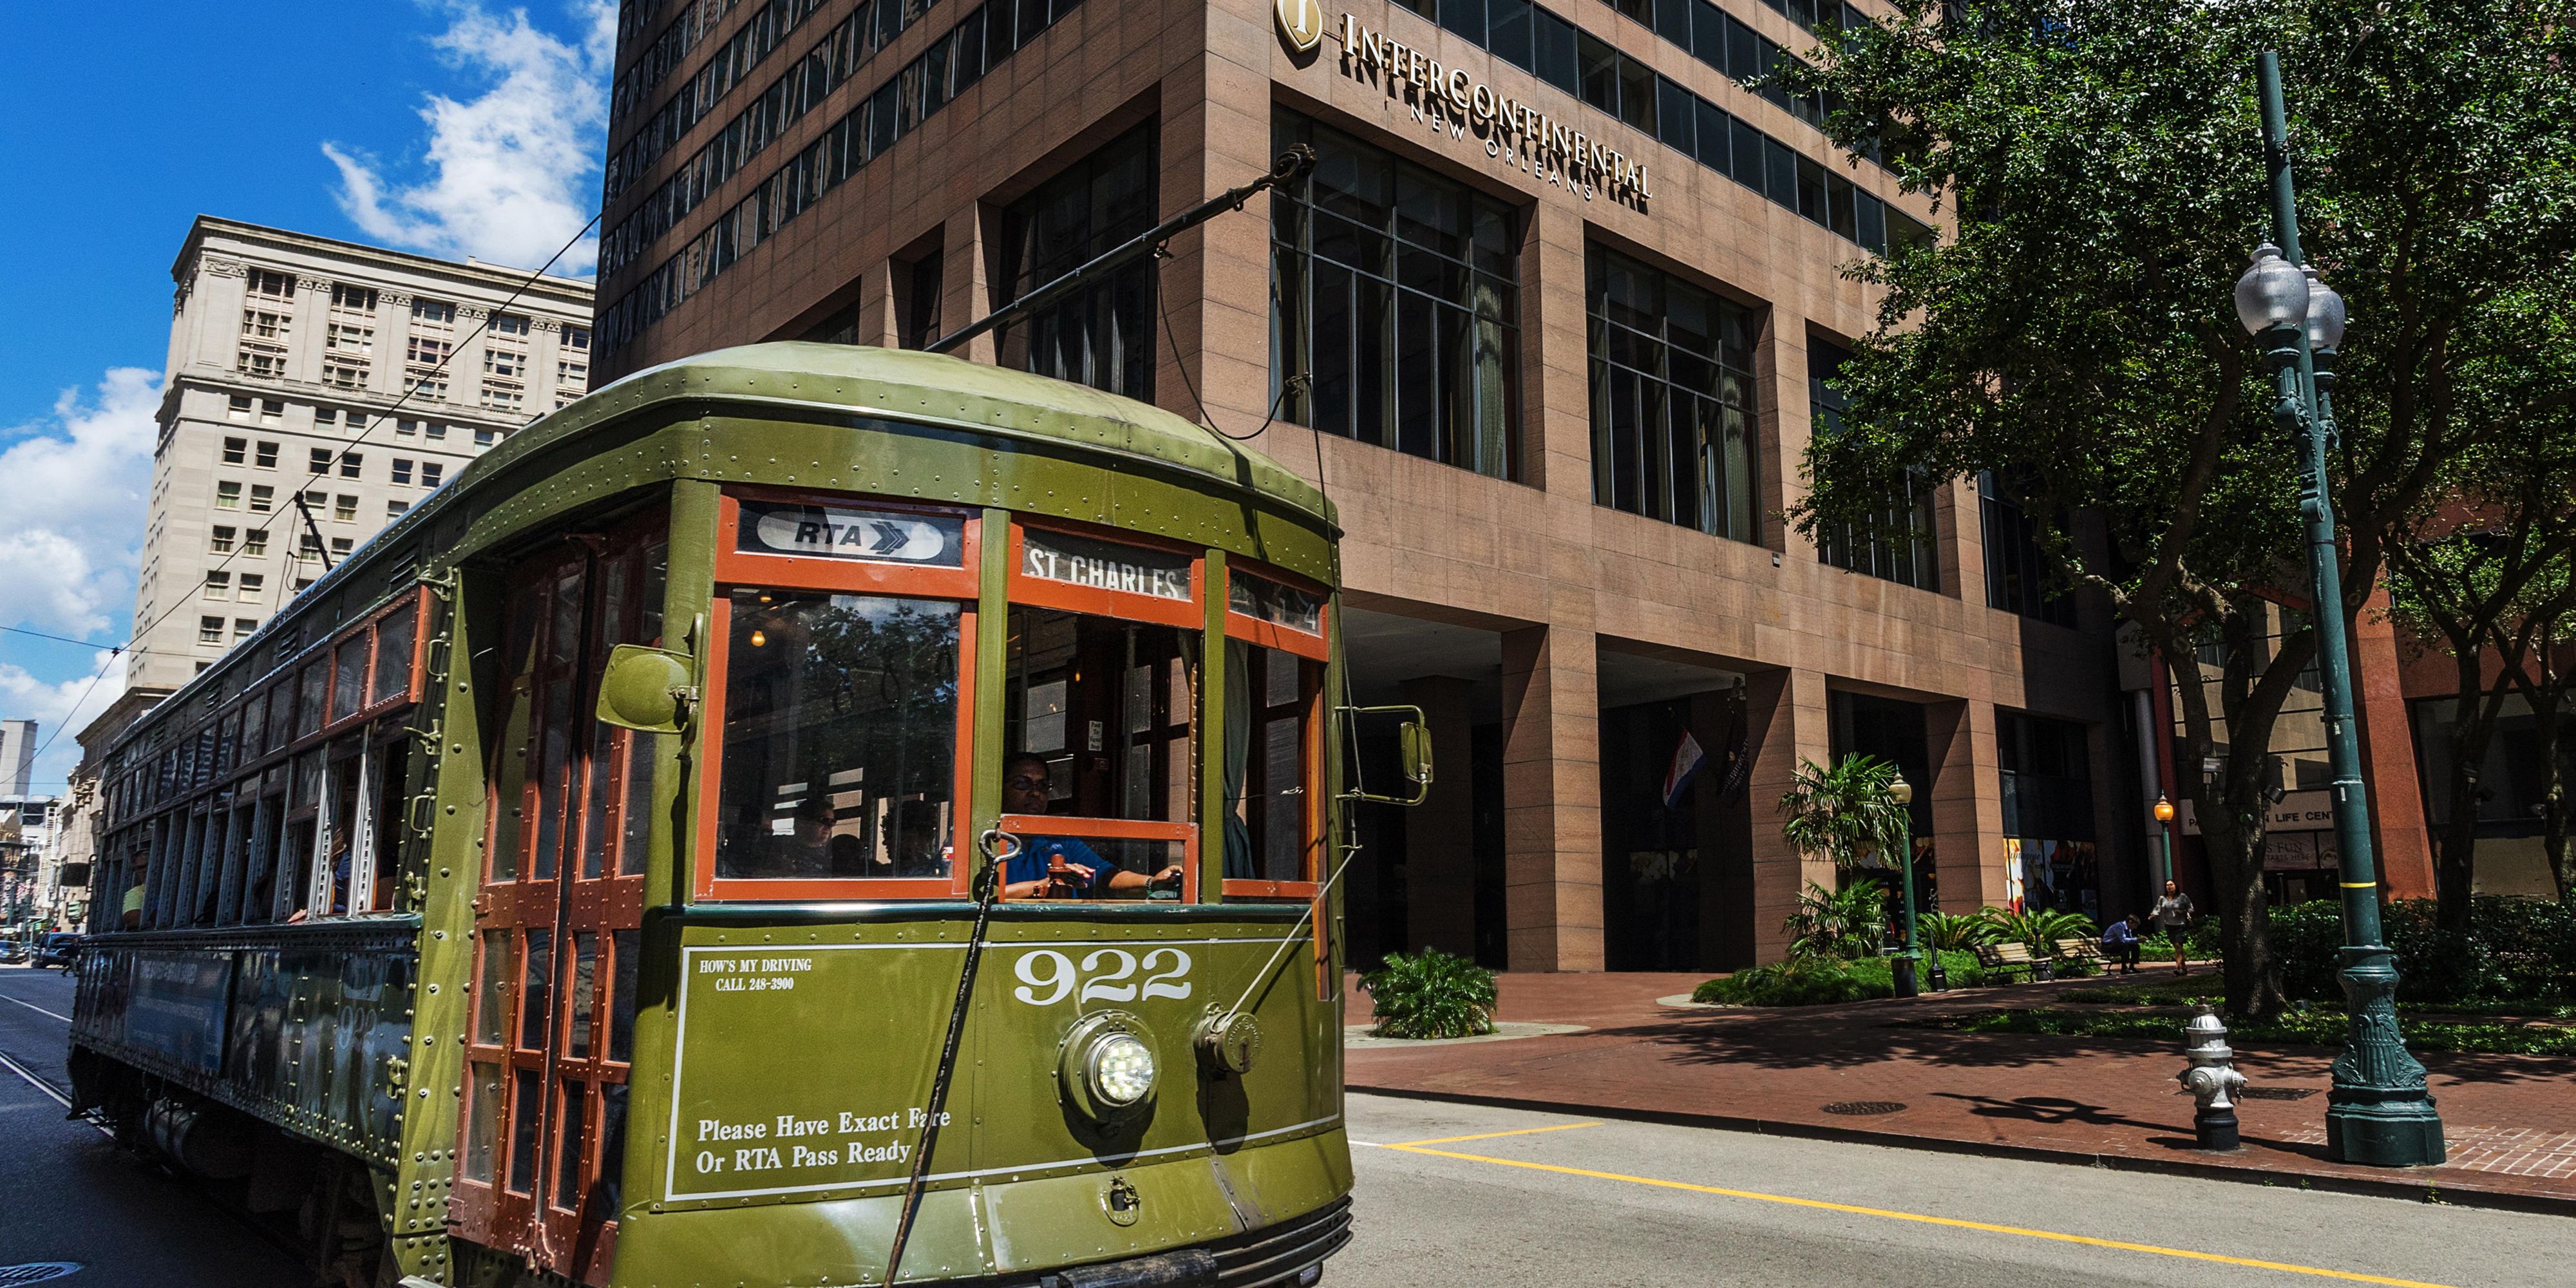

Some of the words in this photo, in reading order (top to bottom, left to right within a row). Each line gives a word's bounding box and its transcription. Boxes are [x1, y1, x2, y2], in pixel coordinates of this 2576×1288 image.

[1342, 12, 1653, 200] INTERCONTINENTAL
[1411, 102, 1466, 142] NEW
[1485, 139, 1593, 200] ORLEANS
[795, 522, 862, 547] RTA
[1029, 548, 1059, 579] ST
[1071, 555, 1179, 600] CHARLES
[2275, 813, 2300, 822] LIFE
[2277, 842, 2302, 853] FUN
[699, 960, 735, 974] HOW'S
[739, 959, 759, 972] MY
[762, 958, 812, 972] DRIVING
[1014, 948, 1192, 1006] 922
[715, 978, 745, 991] CALL
[749, 978, 793, 990] 248-3900
[697, 1119, 766, 1142] Please
[775, 1115, 829, 1138] Have
[838, 1111, 900, 1133] Exact
[696, 1150, 725, 1174] Or
[734, 1147, 782, 1171] RTA
[793, 1145, 838, 1168] Pass
[848, 1139, 911, 1164] Ready
